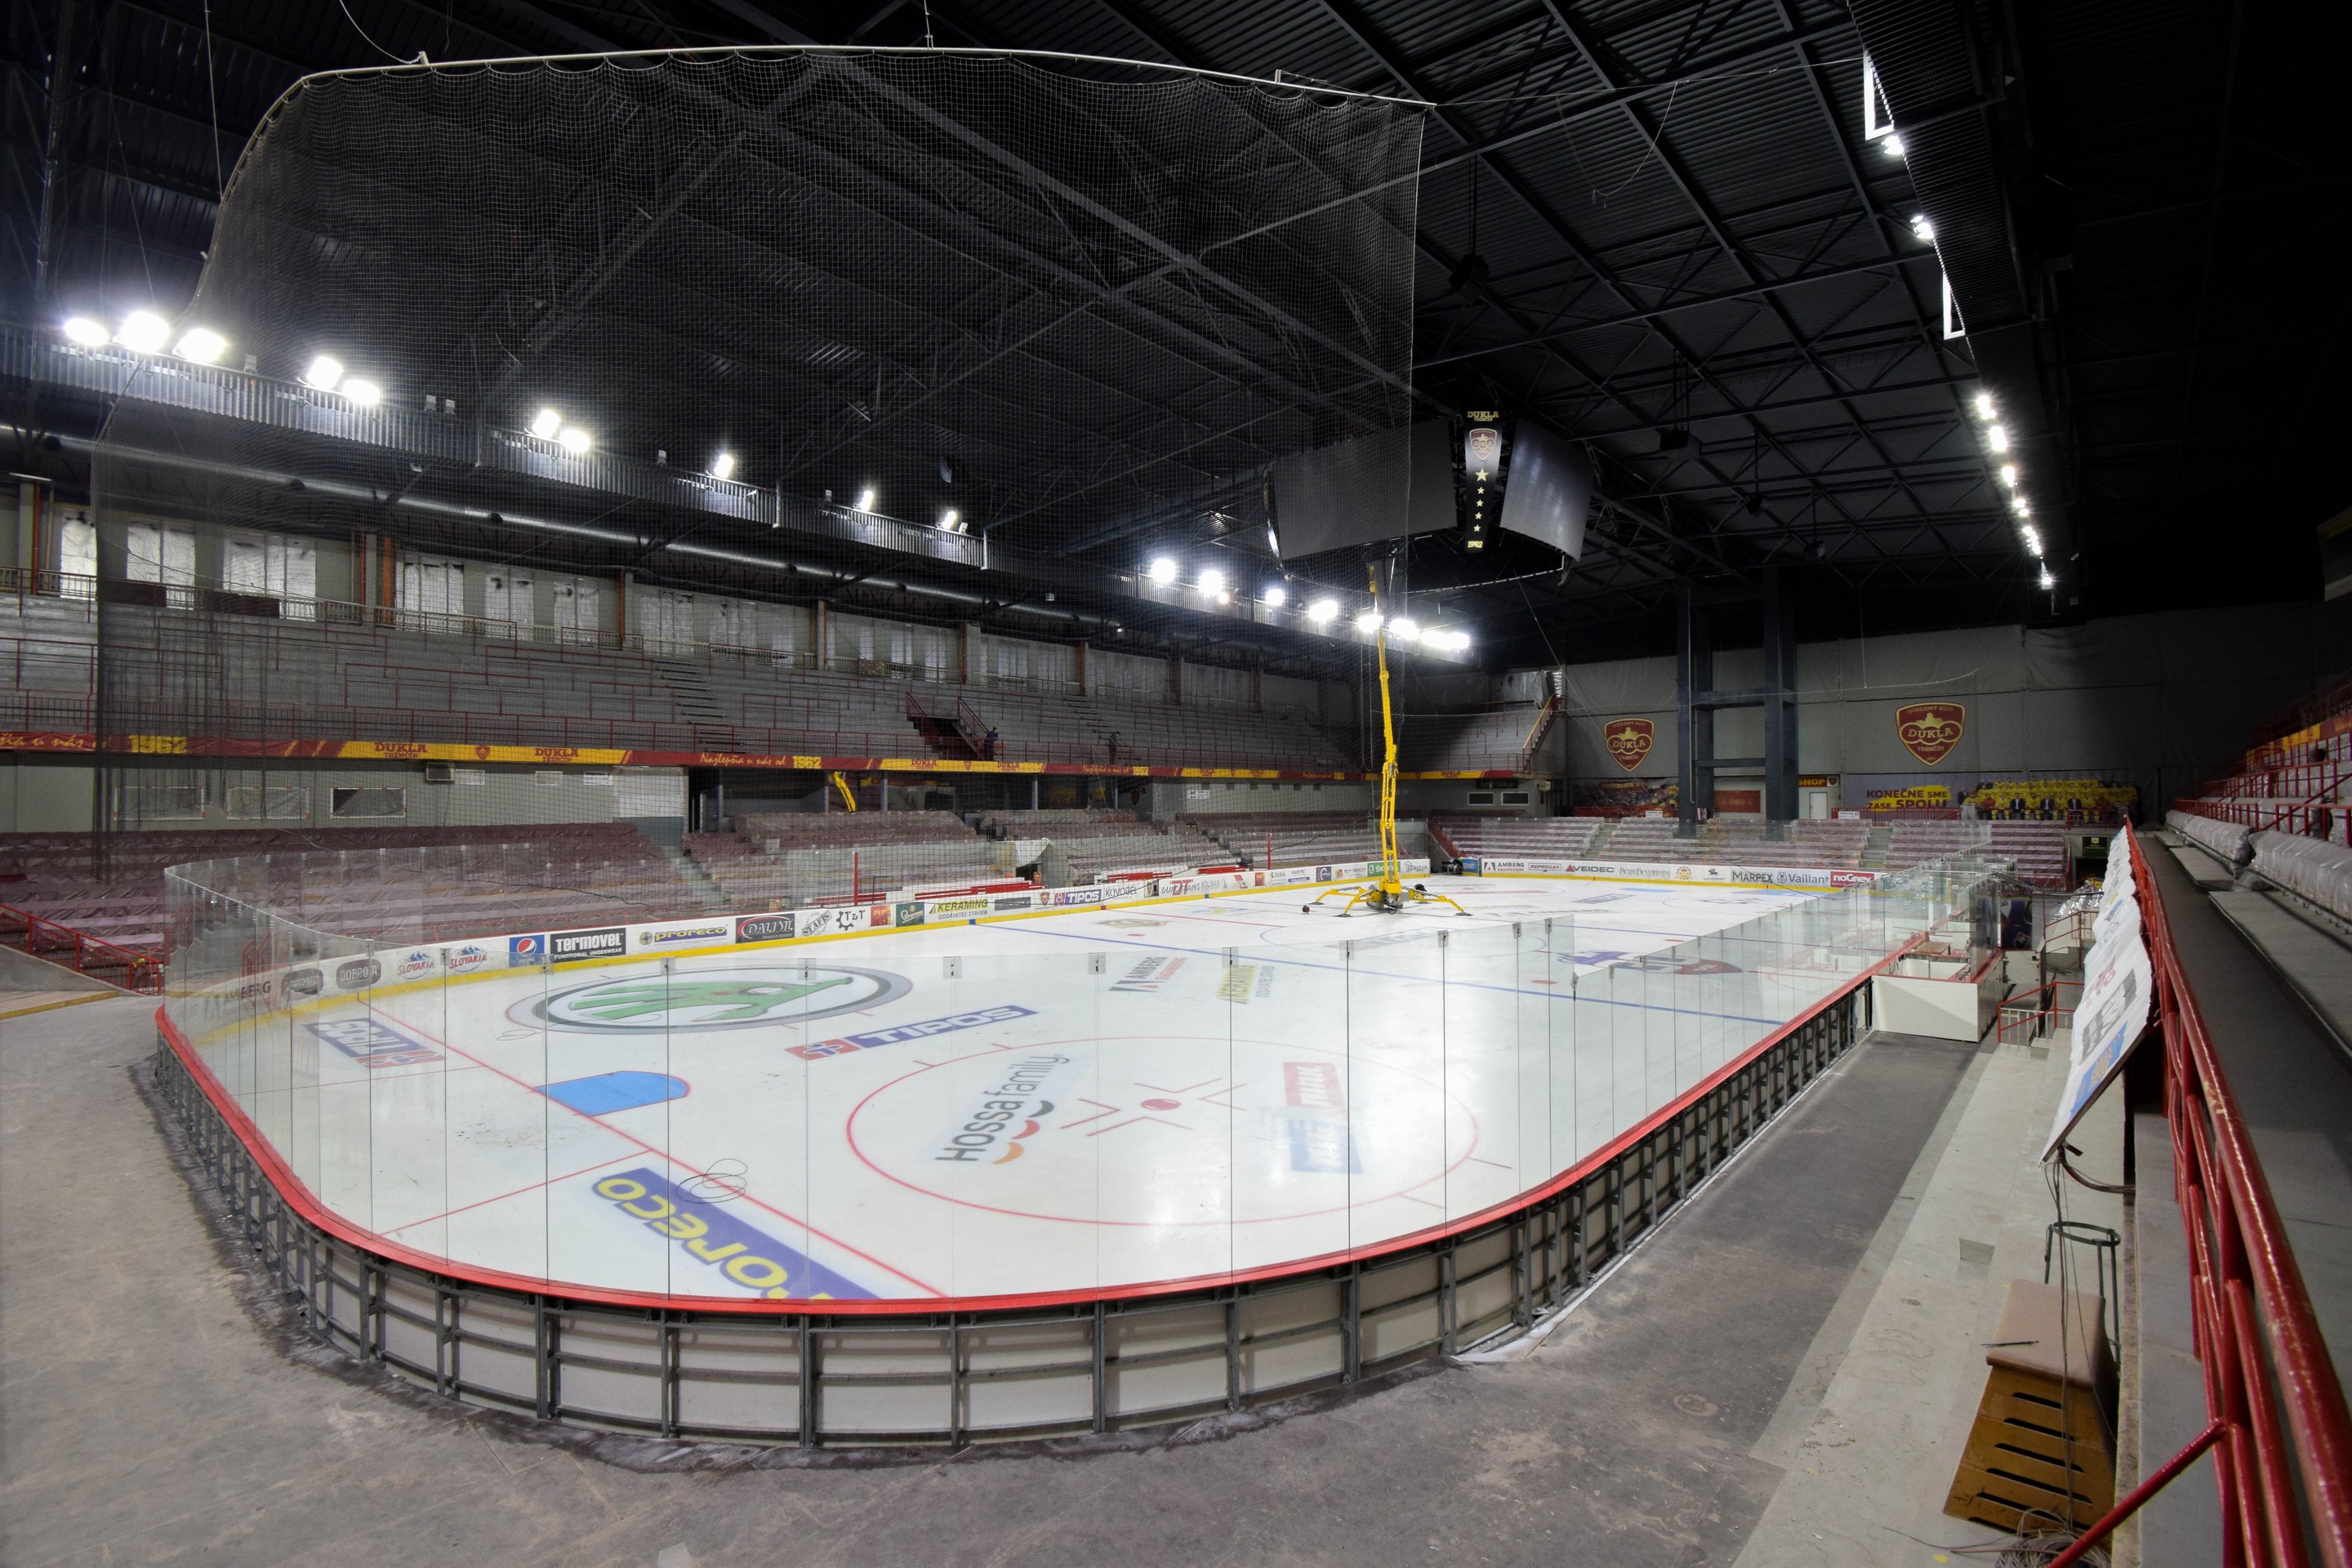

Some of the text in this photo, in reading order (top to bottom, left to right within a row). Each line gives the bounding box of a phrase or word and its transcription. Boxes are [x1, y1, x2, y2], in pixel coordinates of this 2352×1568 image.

[1907, 728, 1953, 738] DUKLA
[129, 735, 188, 754] 1962
[374, 742, 427, 753] DUKLA
[1613, 739, 1646, 749] DUKLA
[535, 748, 578, 757] DUKLA
[701, 753, 744, 766] Najlepšia
[792, 755, 821, 768] 1962
[1867, 788, 1923, 798] KONEČNE
[1896, 800, 1947, 809] SPOLU
[1789, 874, 1829, 884] Vaillant
[1068, 892, 1100, 903] TIPOS
[938, 899, 987, 912] KERAMING
[655, 927, 727, 941] proreco
[590, 947, 622, 956] UNDERWEAR
[449, 952, 487, 969] SLOVAKIA
[398, 960, 434, 975] SLOVAKIA
[340, 965, 377, 982] DOBROA
[859, 1006, 1024, 1042] TIPOS
